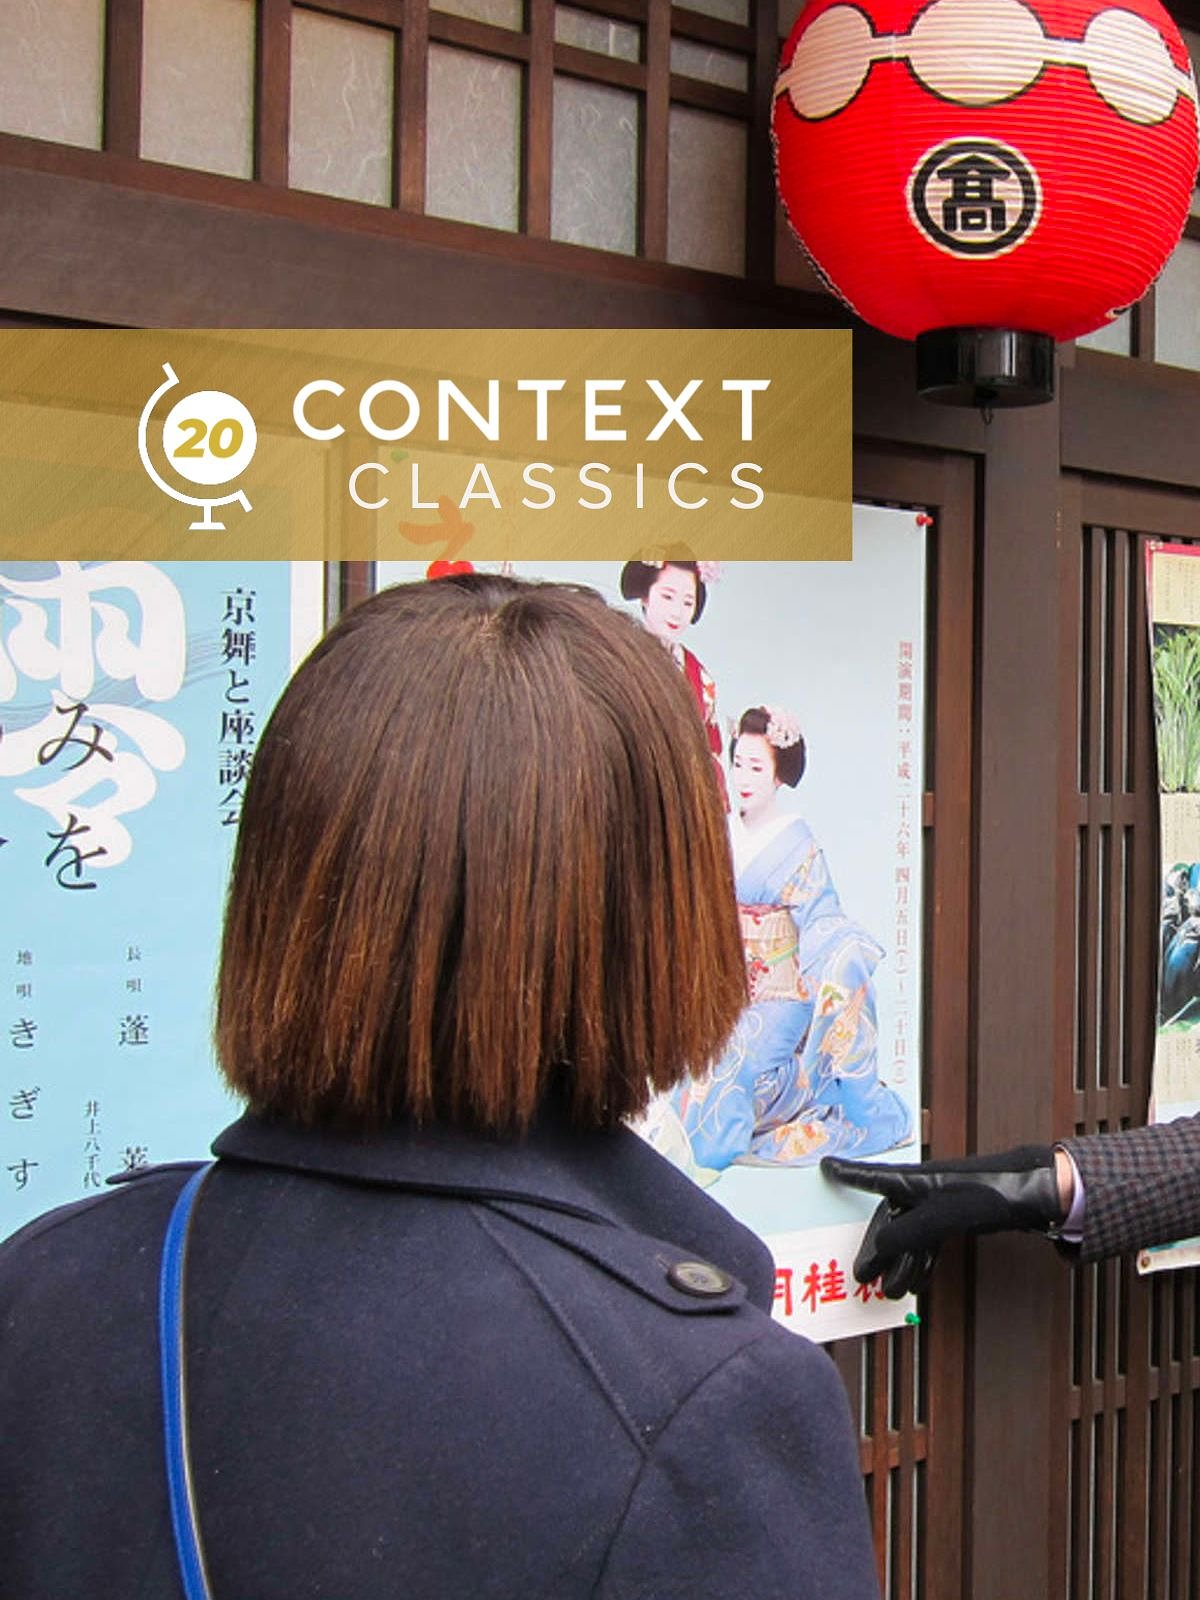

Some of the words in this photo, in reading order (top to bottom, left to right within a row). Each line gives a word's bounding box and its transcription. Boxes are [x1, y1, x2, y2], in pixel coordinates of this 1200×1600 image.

[7, 1017, 41, 1192] きぎす
[83, 1099, 101, 1190] 井上八千代
